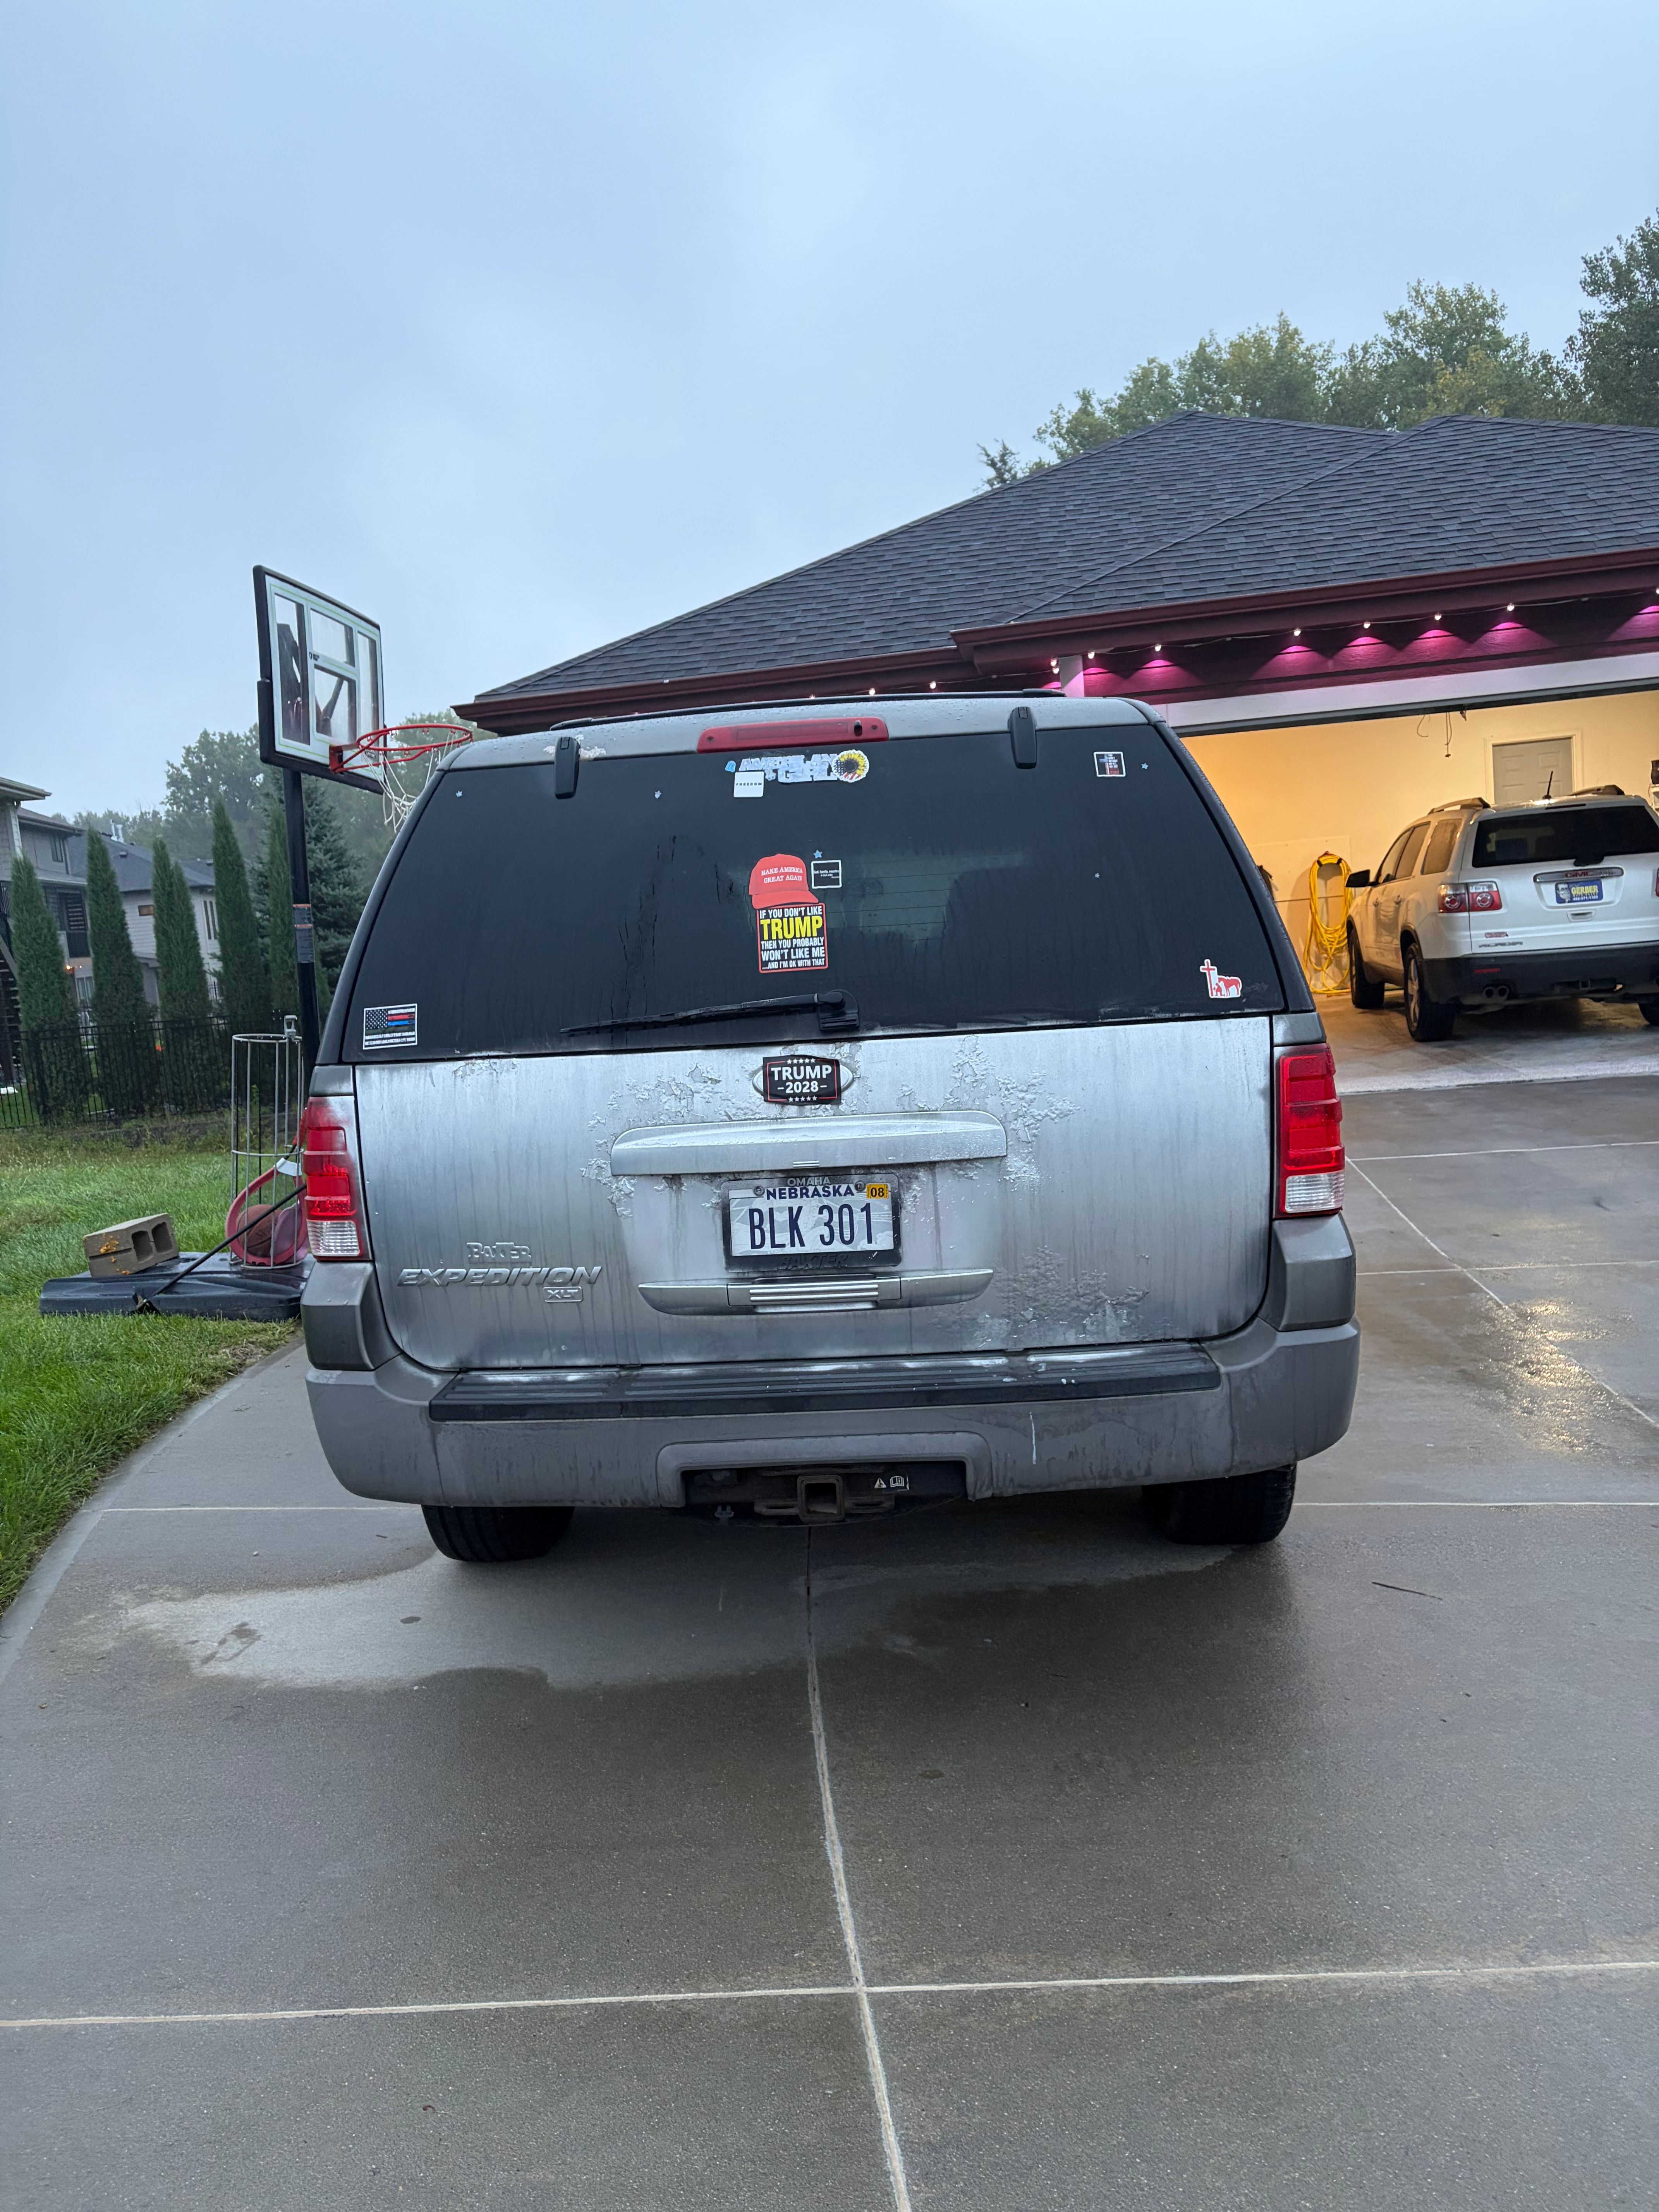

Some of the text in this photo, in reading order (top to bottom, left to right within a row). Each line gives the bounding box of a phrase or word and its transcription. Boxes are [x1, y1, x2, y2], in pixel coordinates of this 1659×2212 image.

[761, 867, 778, 876] MAKE
[760, 906, 822, 919] IF YOU DON'T LIKE
[760, 915, 823, 940] TRUMP
[761, 936, 824, 950] THEN YOU PROBABLY
[761, 947, 825, 961] WON'T LIKE ME
[771, 1065, 832, 1081] TRUMP
[787, 1176, 830, 1187] OMAHA
[766, 1184, 855, 1200] NEBRASKA
[871, 1187, 884, 1197] 08
[749, 1202, 872, 1249] BLK 301
[777, 1253, 848, 1270] BAXTER
[398, 1266, 601, 1286] EXPEDITION
[547, 1289, 579, 1299] XLT
